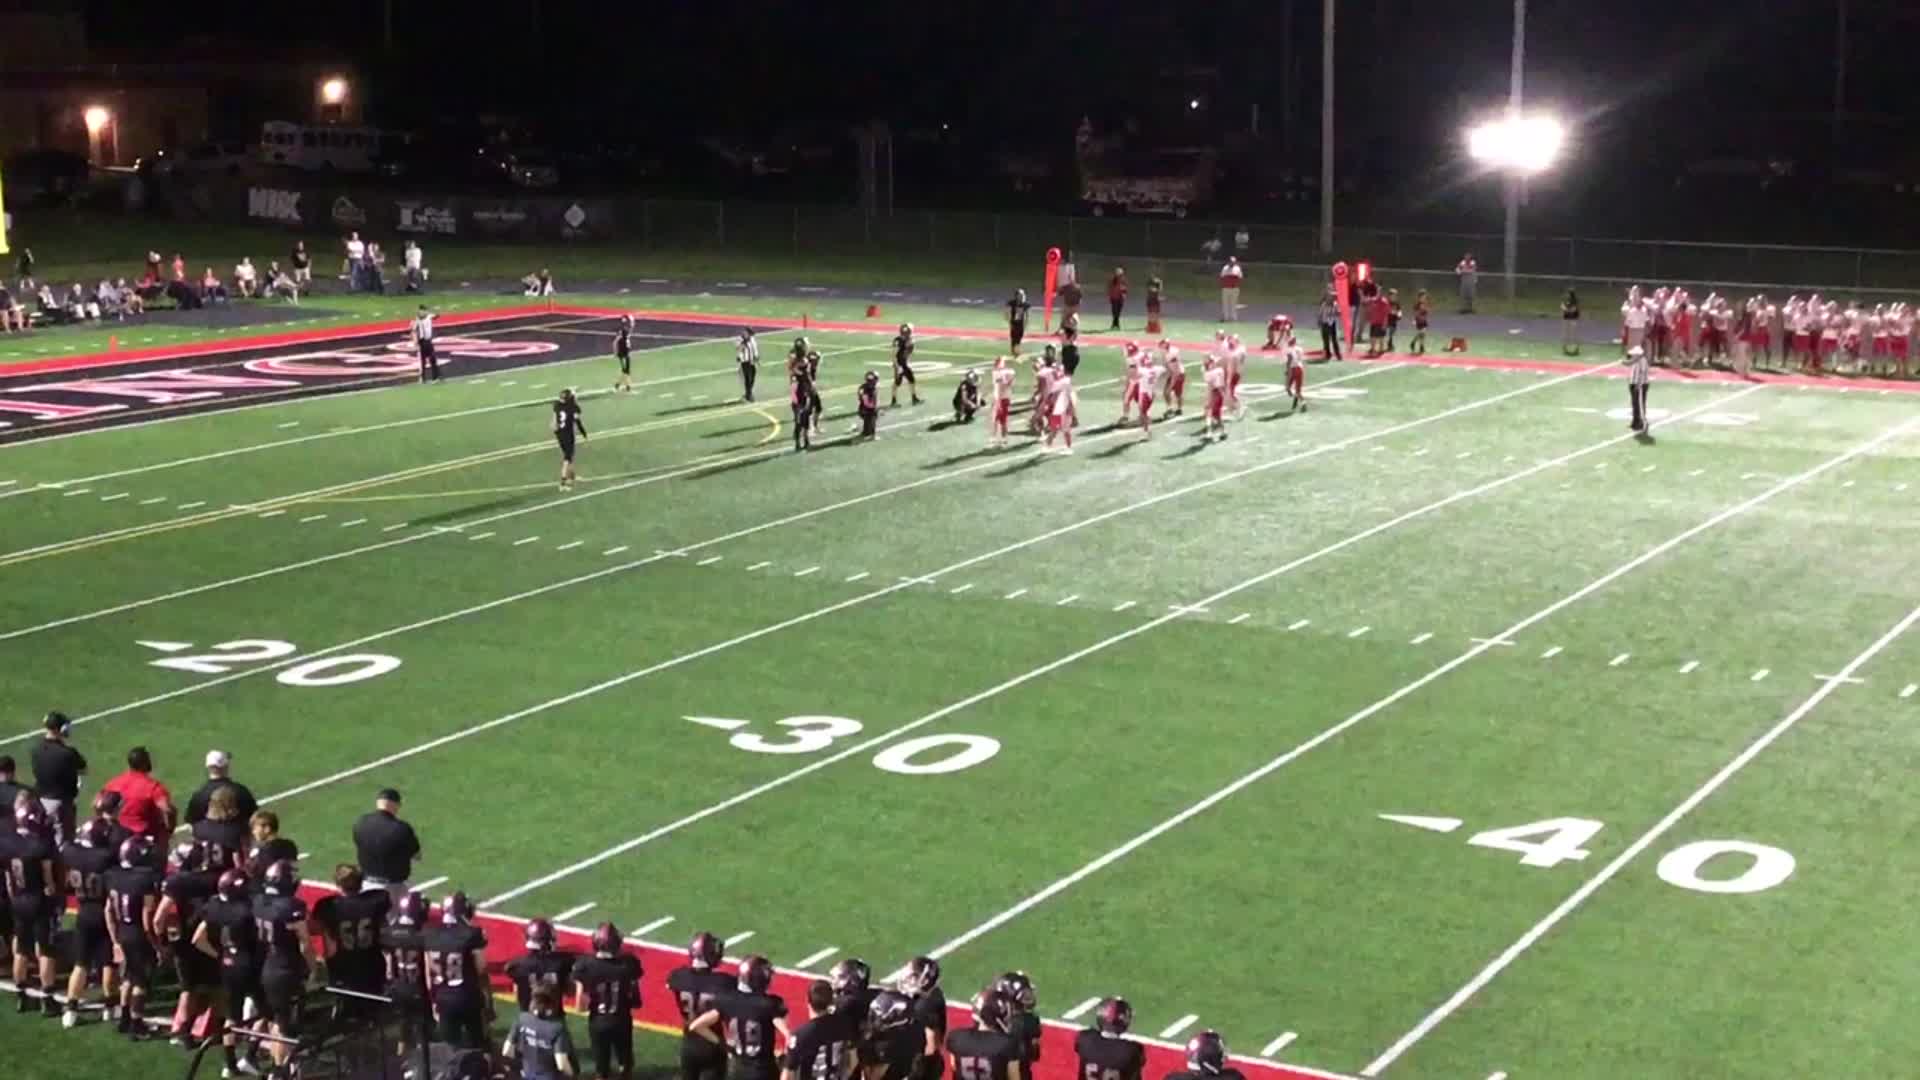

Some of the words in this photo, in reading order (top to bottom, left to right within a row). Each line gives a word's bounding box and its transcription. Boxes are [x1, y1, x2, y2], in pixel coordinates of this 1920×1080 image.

[151, 639, 402, 686] 20
[729, 715, 1002, 775] 30
[1467, 817, 1797, 893] 40
